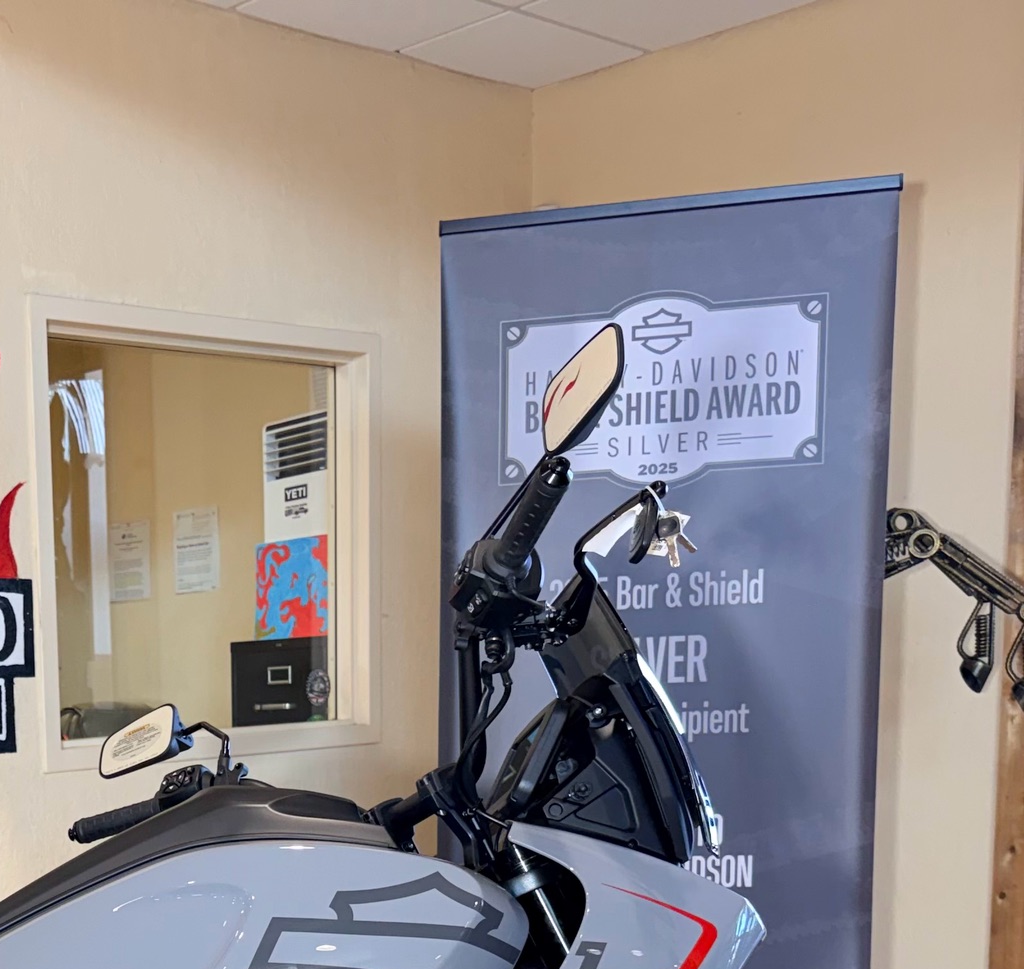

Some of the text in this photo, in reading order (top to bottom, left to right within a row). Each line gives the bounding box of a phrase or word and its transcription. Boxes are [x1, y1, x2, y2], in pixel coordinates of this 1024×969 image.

[608, 380, 801, 427] SHIELD AWARD
[608, 431, 709, 457] SILVER
[637, 462, 678, 476] 2025
[286, 486, 306, 500] YETI
[616, 576, 659, 610] Bar
[665, 573, 683, 608] &
[689, 568, 765, 606] Shield
[681, 700, 750, 743] ipient
